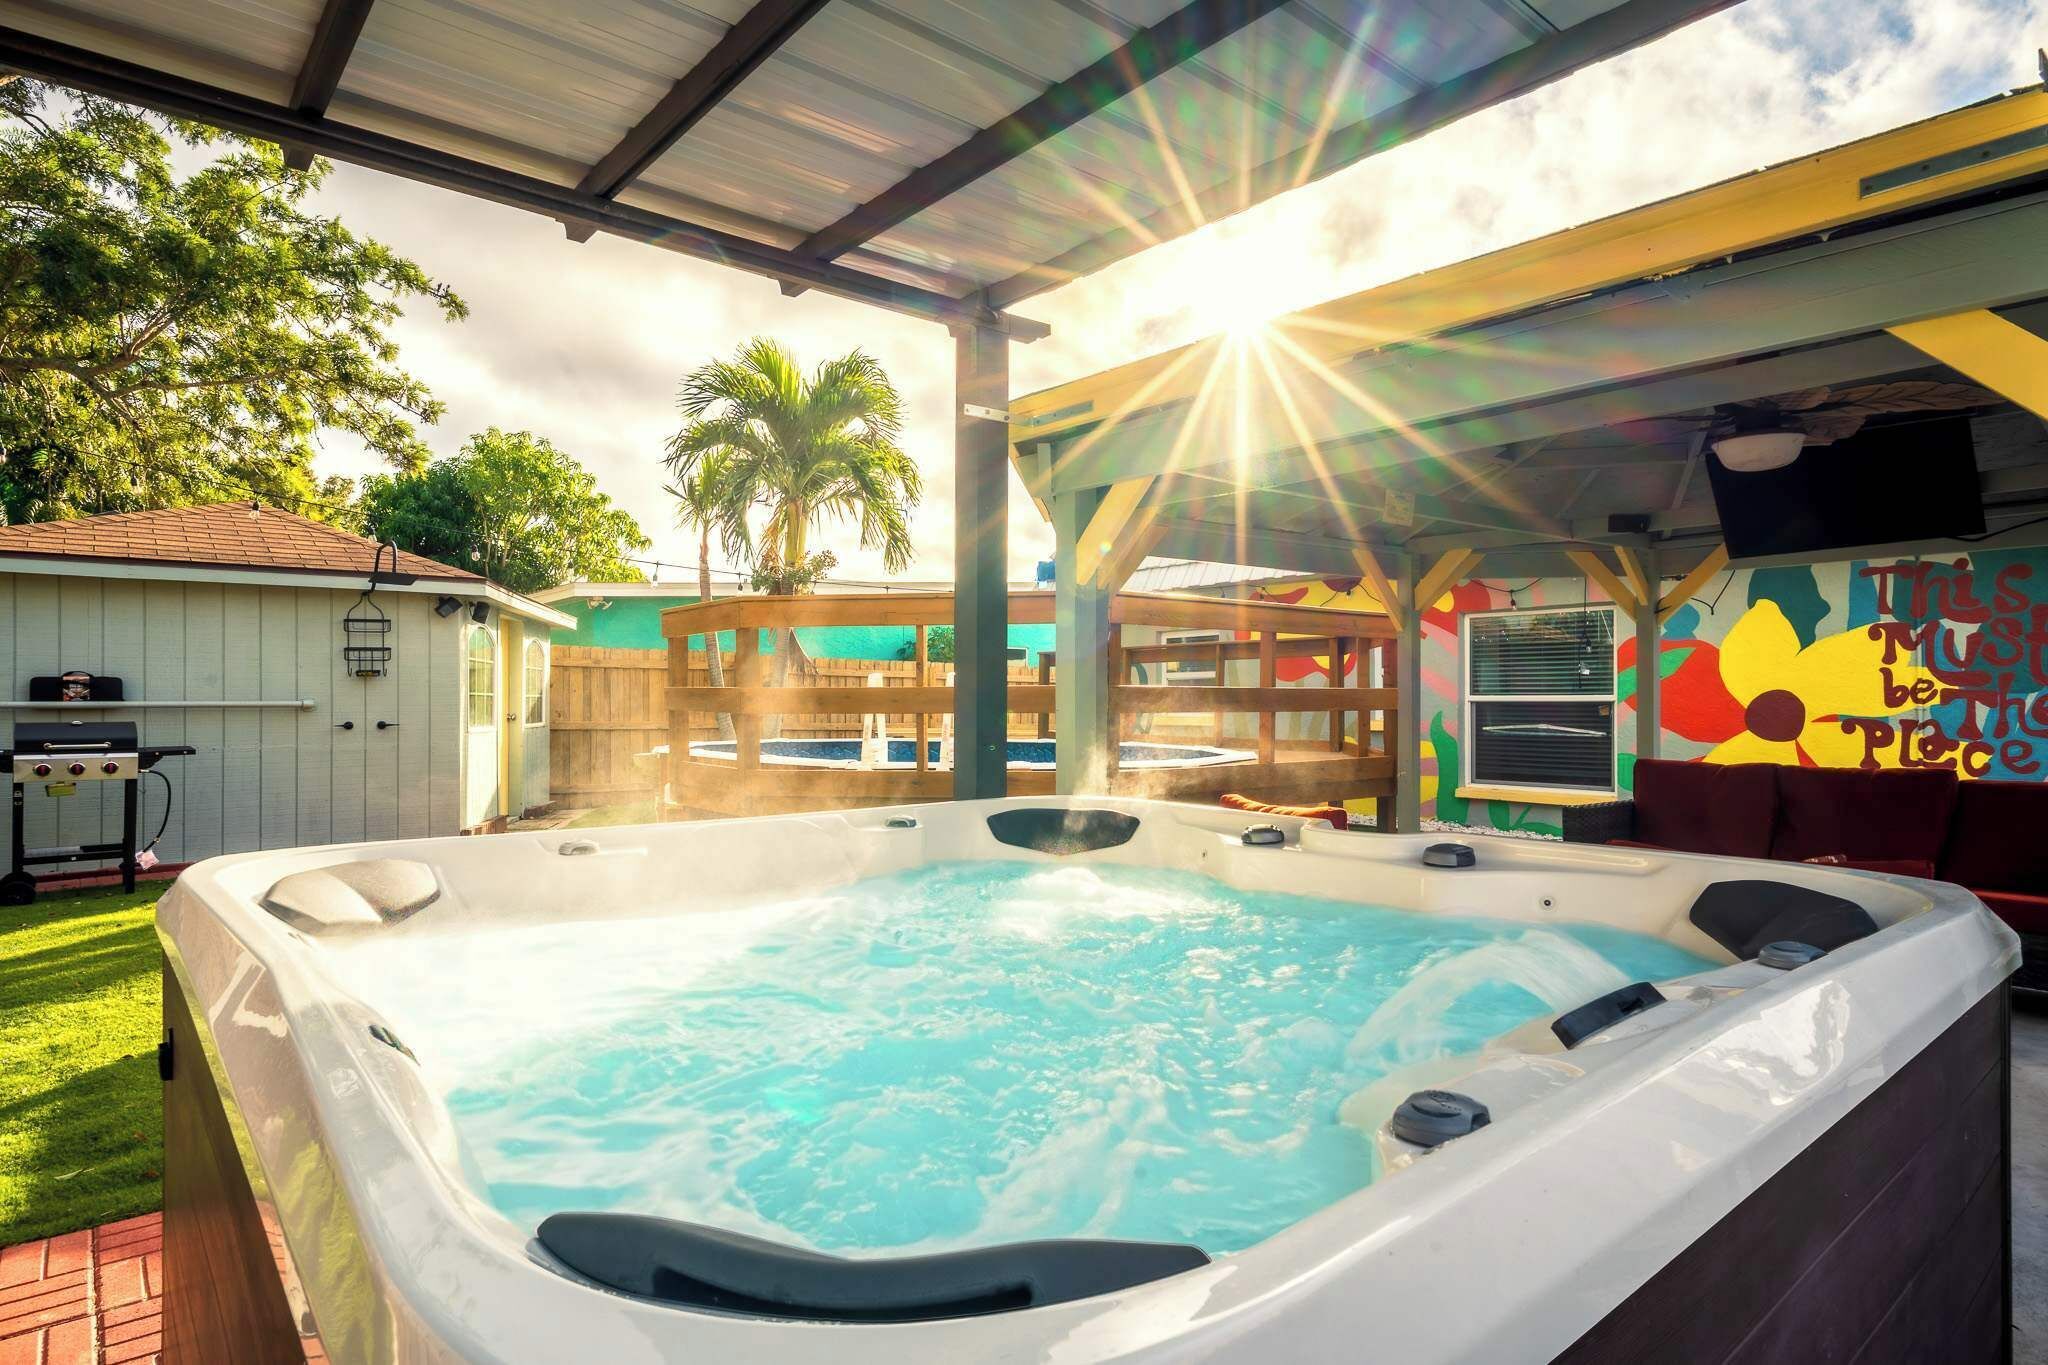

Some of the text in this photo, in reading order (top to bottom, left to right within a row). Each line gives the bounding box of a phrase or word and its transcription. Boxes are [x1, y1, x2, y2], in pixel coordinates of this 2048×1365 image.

[1859, 558, 2033, 624] This
[1879, 667, 1939, 708] be
[1841, 718, 2040, 777] Place
